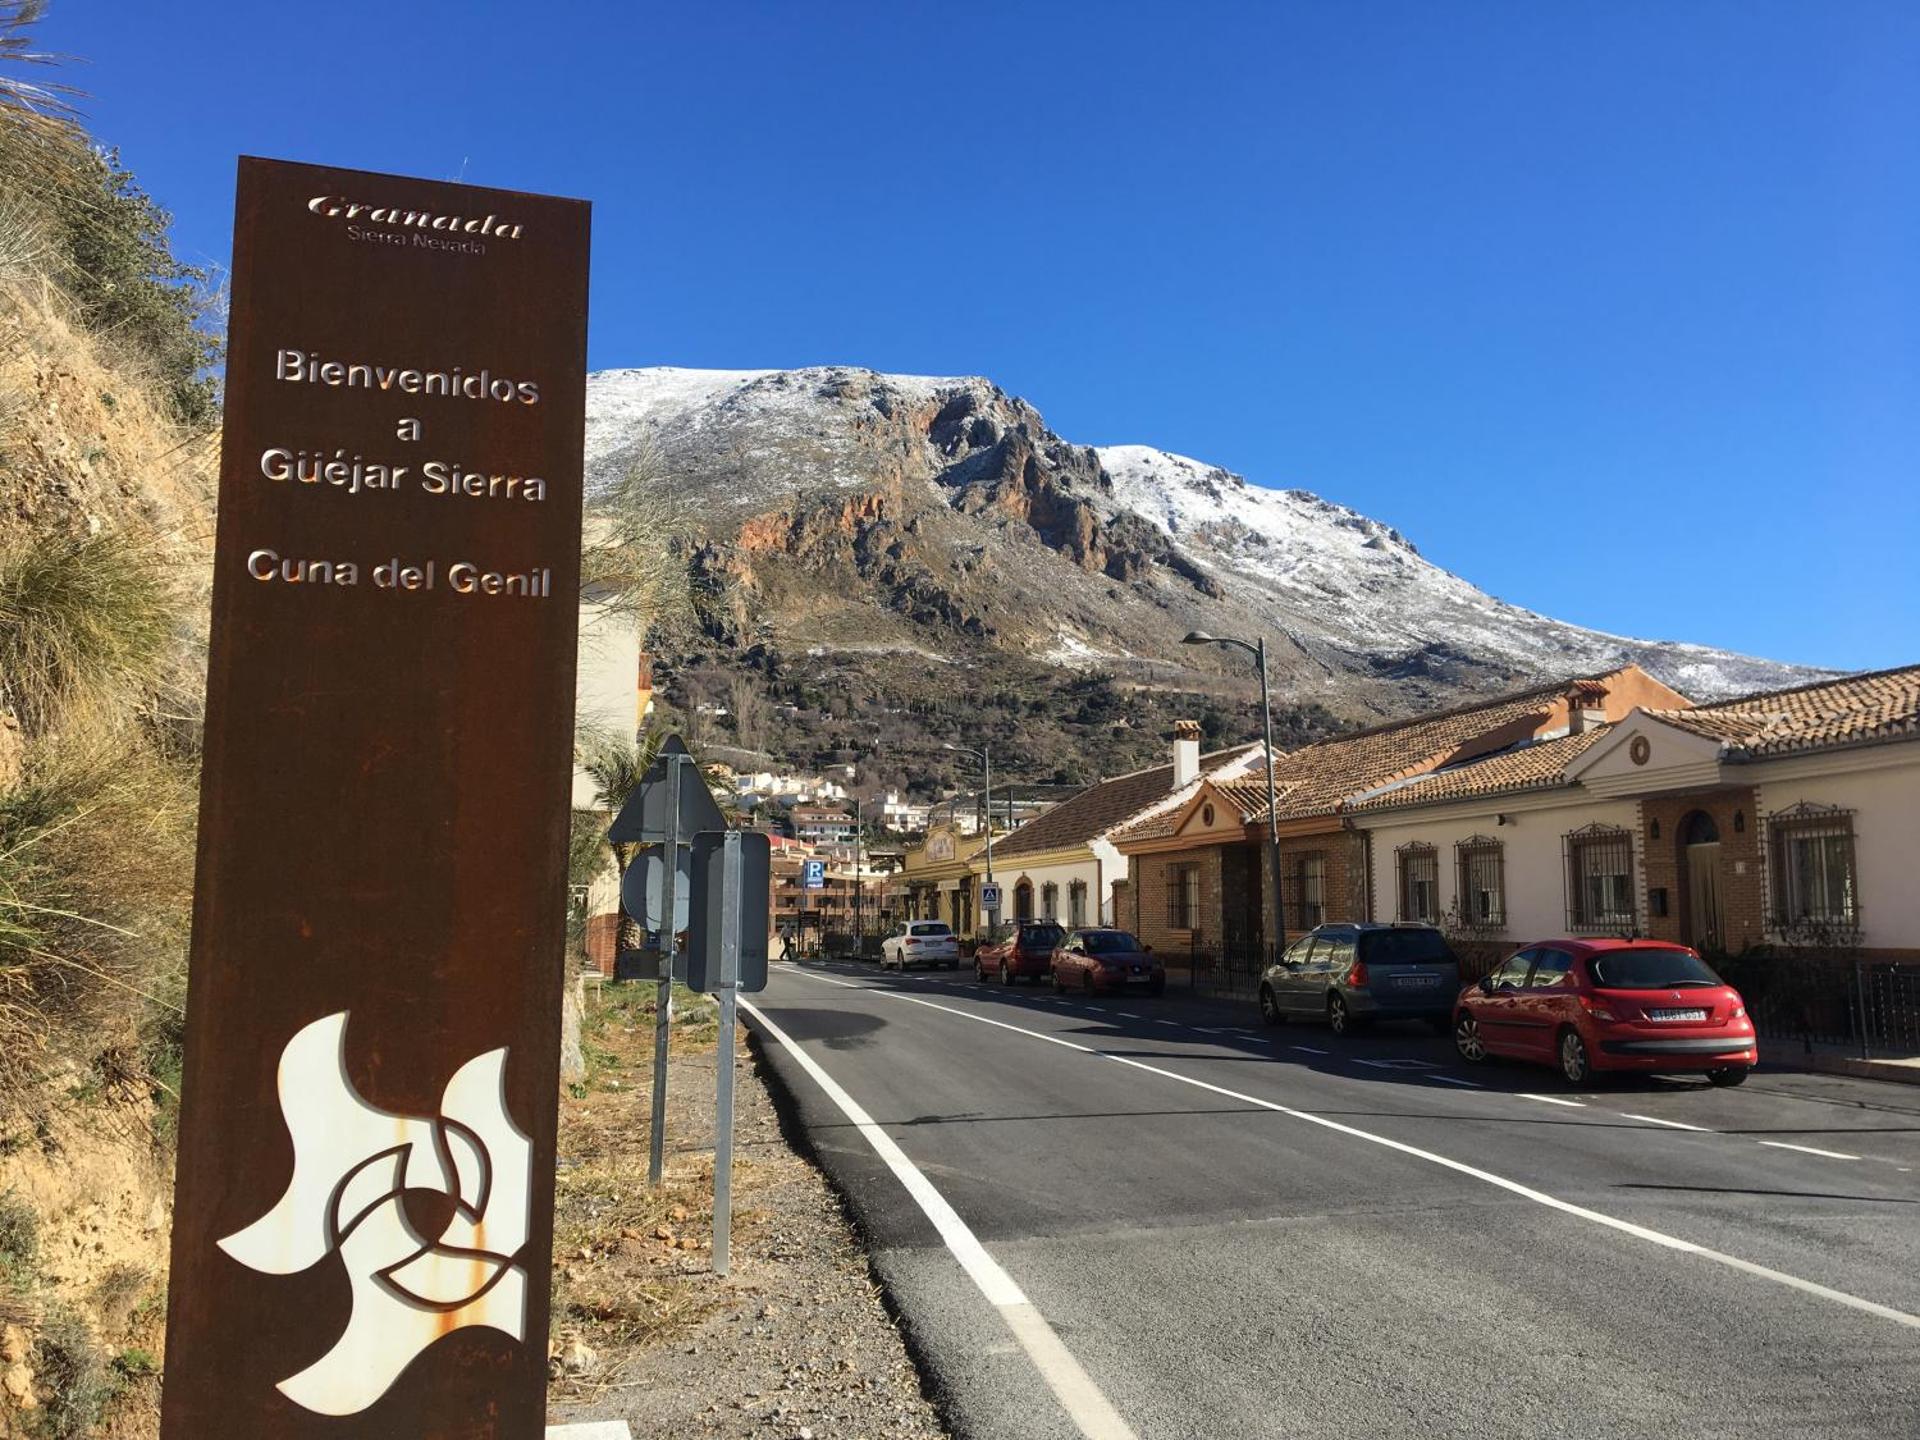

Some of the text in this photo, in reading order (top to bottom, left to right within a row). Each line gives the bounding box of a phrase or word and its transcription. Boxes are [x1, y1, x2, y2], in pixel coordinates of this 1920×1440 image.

[307, 195, 525, 239] Granada
[348, 225, 486, 255] Sierra Nevada
[276, 350, 540, 404] Bienvenidos
[396, 417, 421, 441] a
[260, 448, 546, 500] Güéjar Sierra
[247, 549, 550, 597] Cuna del Genil
